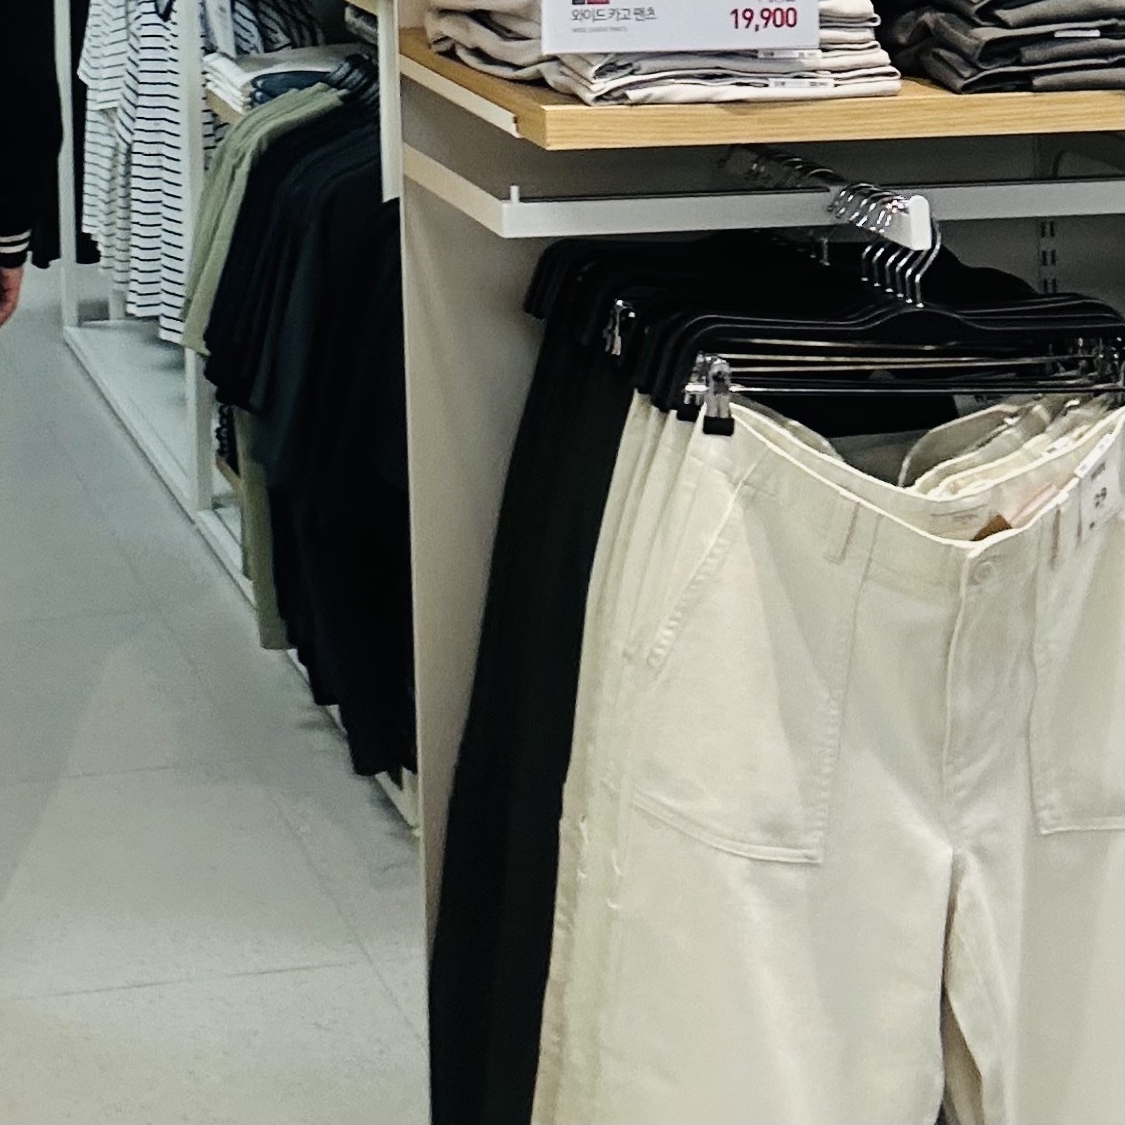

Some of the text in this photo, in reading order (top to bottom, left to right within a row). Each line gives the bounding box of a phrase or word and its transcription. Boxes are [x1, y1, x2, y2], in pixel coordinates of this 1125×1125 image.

[572, 8, 607, 23] 와이드
[608, 7, 632, 22] 카고
[730, 7, 797, 32] 19,900
